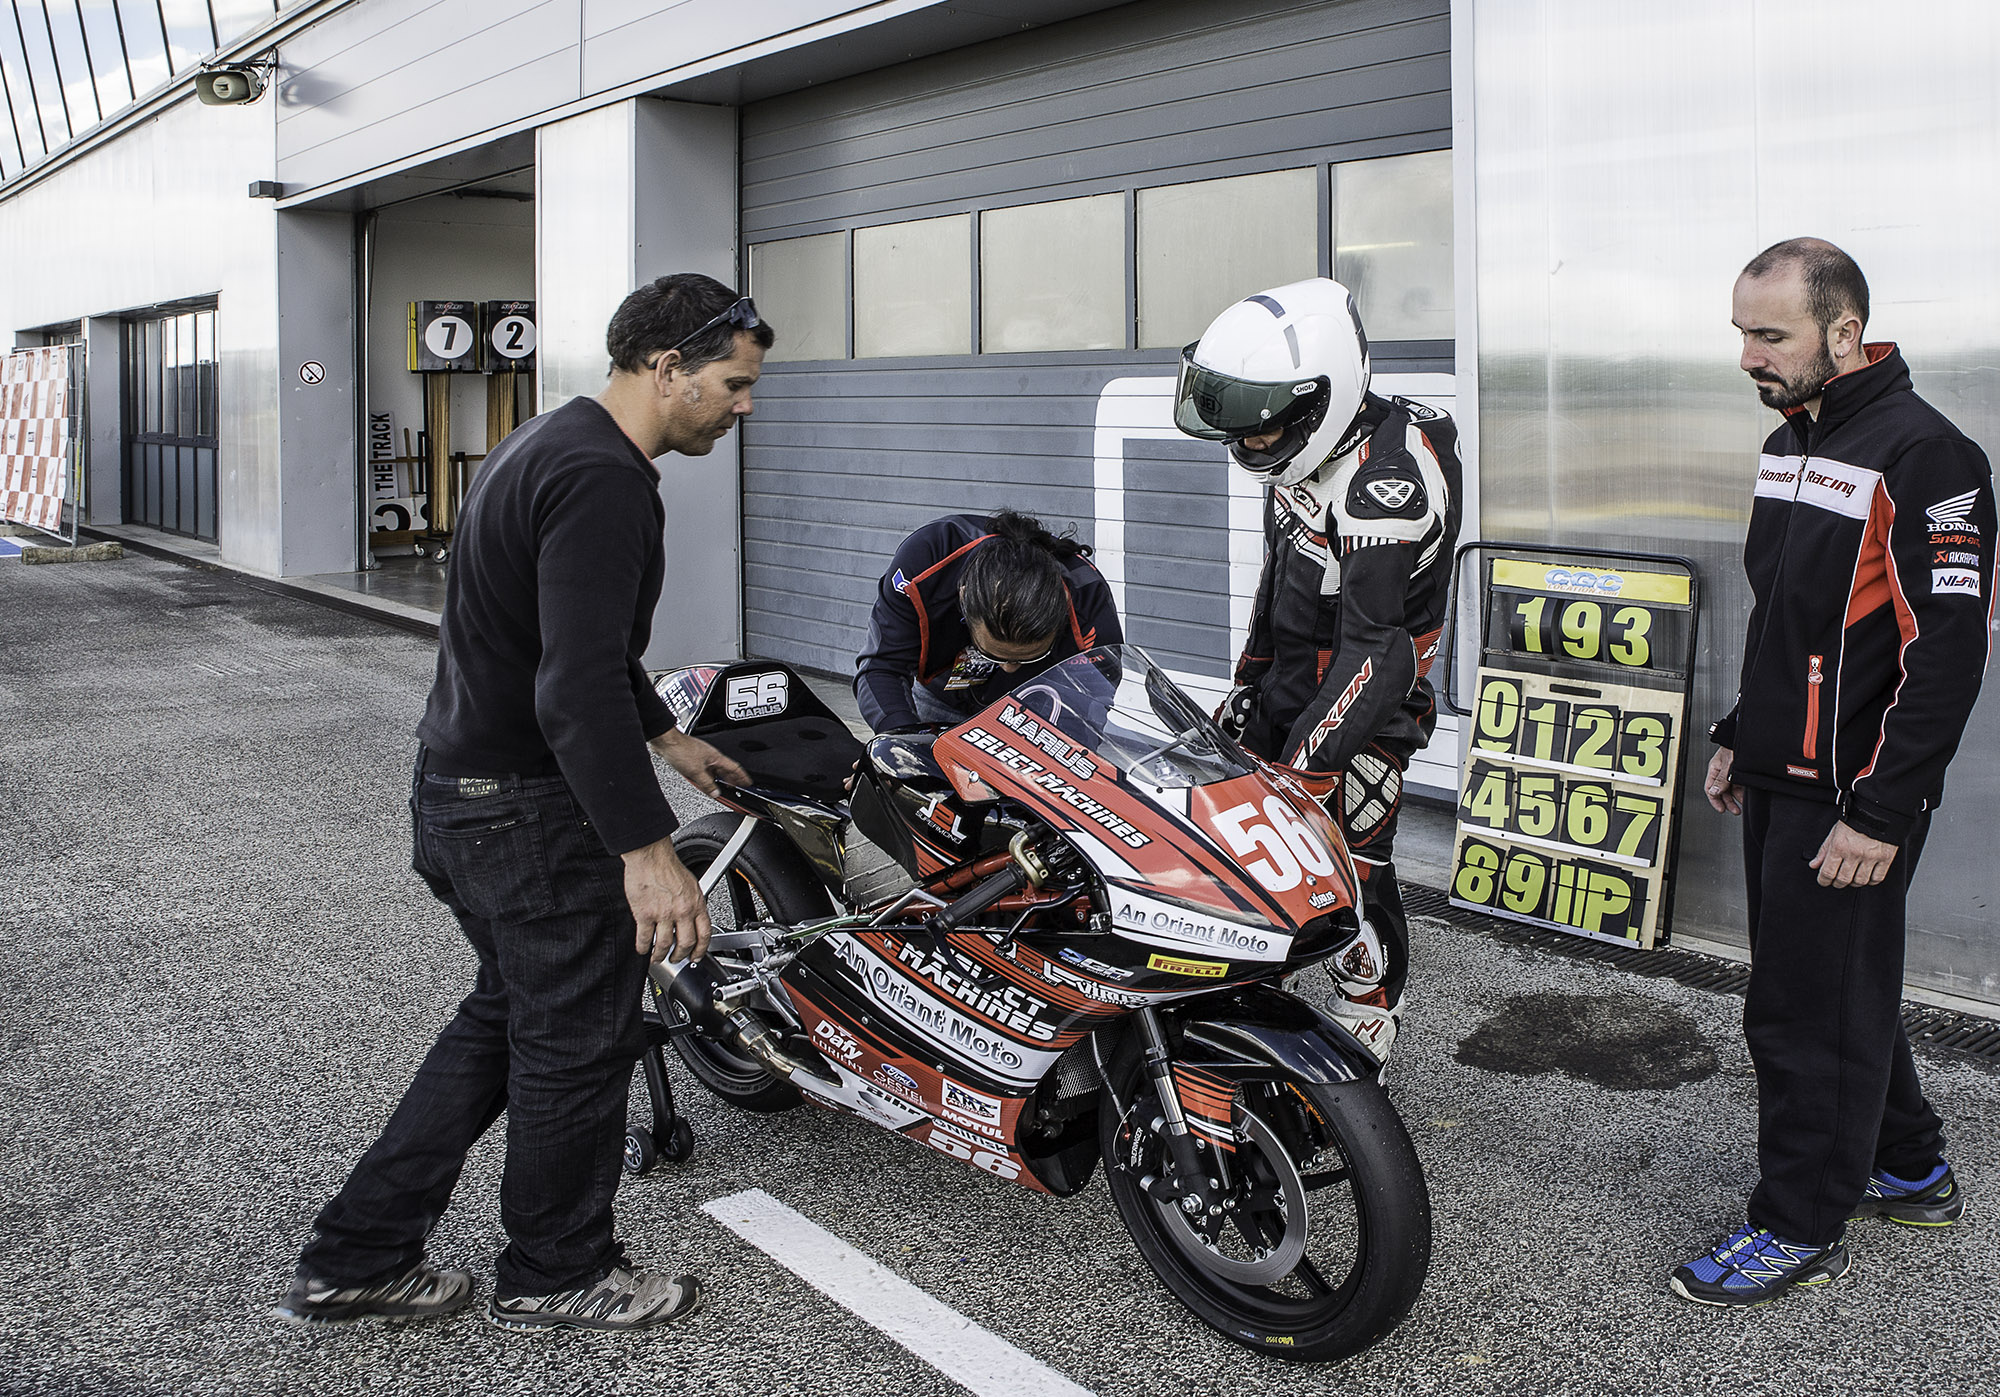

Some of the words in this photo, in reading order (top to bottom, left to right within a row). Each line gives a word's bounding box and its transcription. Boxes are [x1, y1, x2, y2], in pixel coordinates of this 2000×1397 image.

[441, 322, 457, 350] 7
[506, 321, 524, 350] 2
[1296, 384, 1314, 393] SHOEI
[371, 412, 393, 459] TRACK
[375, 462, 394, 492] THE
[1759, 468, 1794, 483] Honda
[1805, 470, 1857, 498] Racing
[1926, 522, 1980, 535] HONDA
[727, 671, 788, 719] 56
[734, 703, 783, 719] MARIUS
[958, 727, 1047, 777] SELECT
[996, 702, 1097, 780] MARIUS
[915, 810, 961, 845] SUPERMONO
[1210, 795, 1335, 892] 56
[1114, 903, 1147, 924] An
[1151, 910, 1216, 943] Oriant
[1219, 927, 1269, 953] Moto
[1153, 958, 1223, 977] PIRELLI
[833, 941, 869, 977] An
[872, 967, 946, 1034] Oriant
[949, 1017, 1023, 1070] Moto
[812, 1035, 865, 1074] LORIENT
[814, 1019, 864, 1060] Dafy
[871, 1069, 925, 1104] GESTEL
[941, 1109, 1006, 1140] MOTUL
[928, 1128, 1022, 1180] 56
